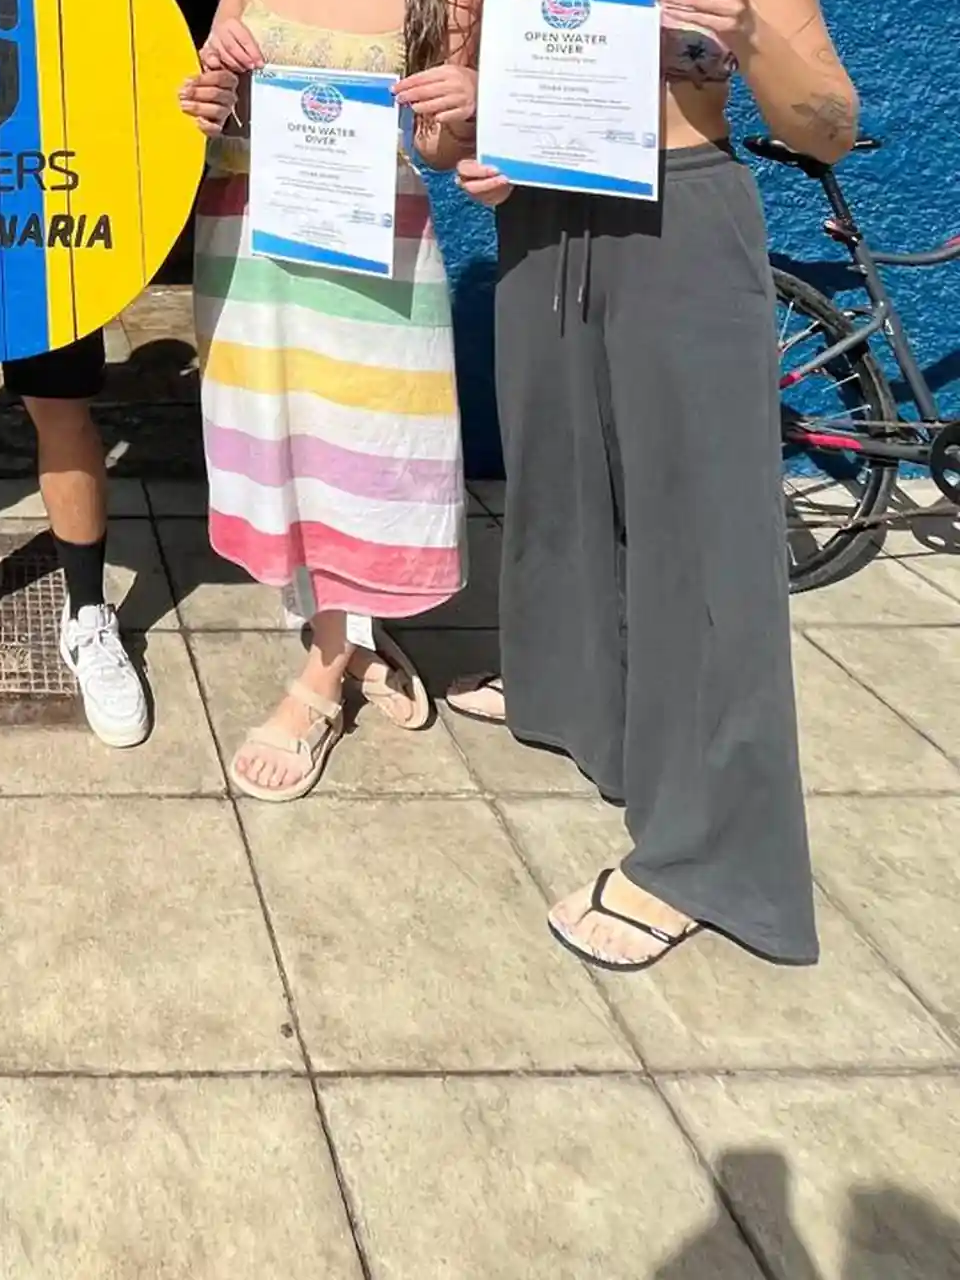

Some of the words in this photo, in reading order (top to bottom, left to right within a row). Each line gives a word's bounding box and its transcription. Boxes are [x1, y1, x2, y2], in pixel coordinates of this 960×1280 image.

[524, 30, 559, 43] OPEN
[562, 33, 608, 45] WATER
[545, 43, 584, 55] DIVER
[287, 122, 316, 134] OPEN
[318, 126, 356, 138] WATER
